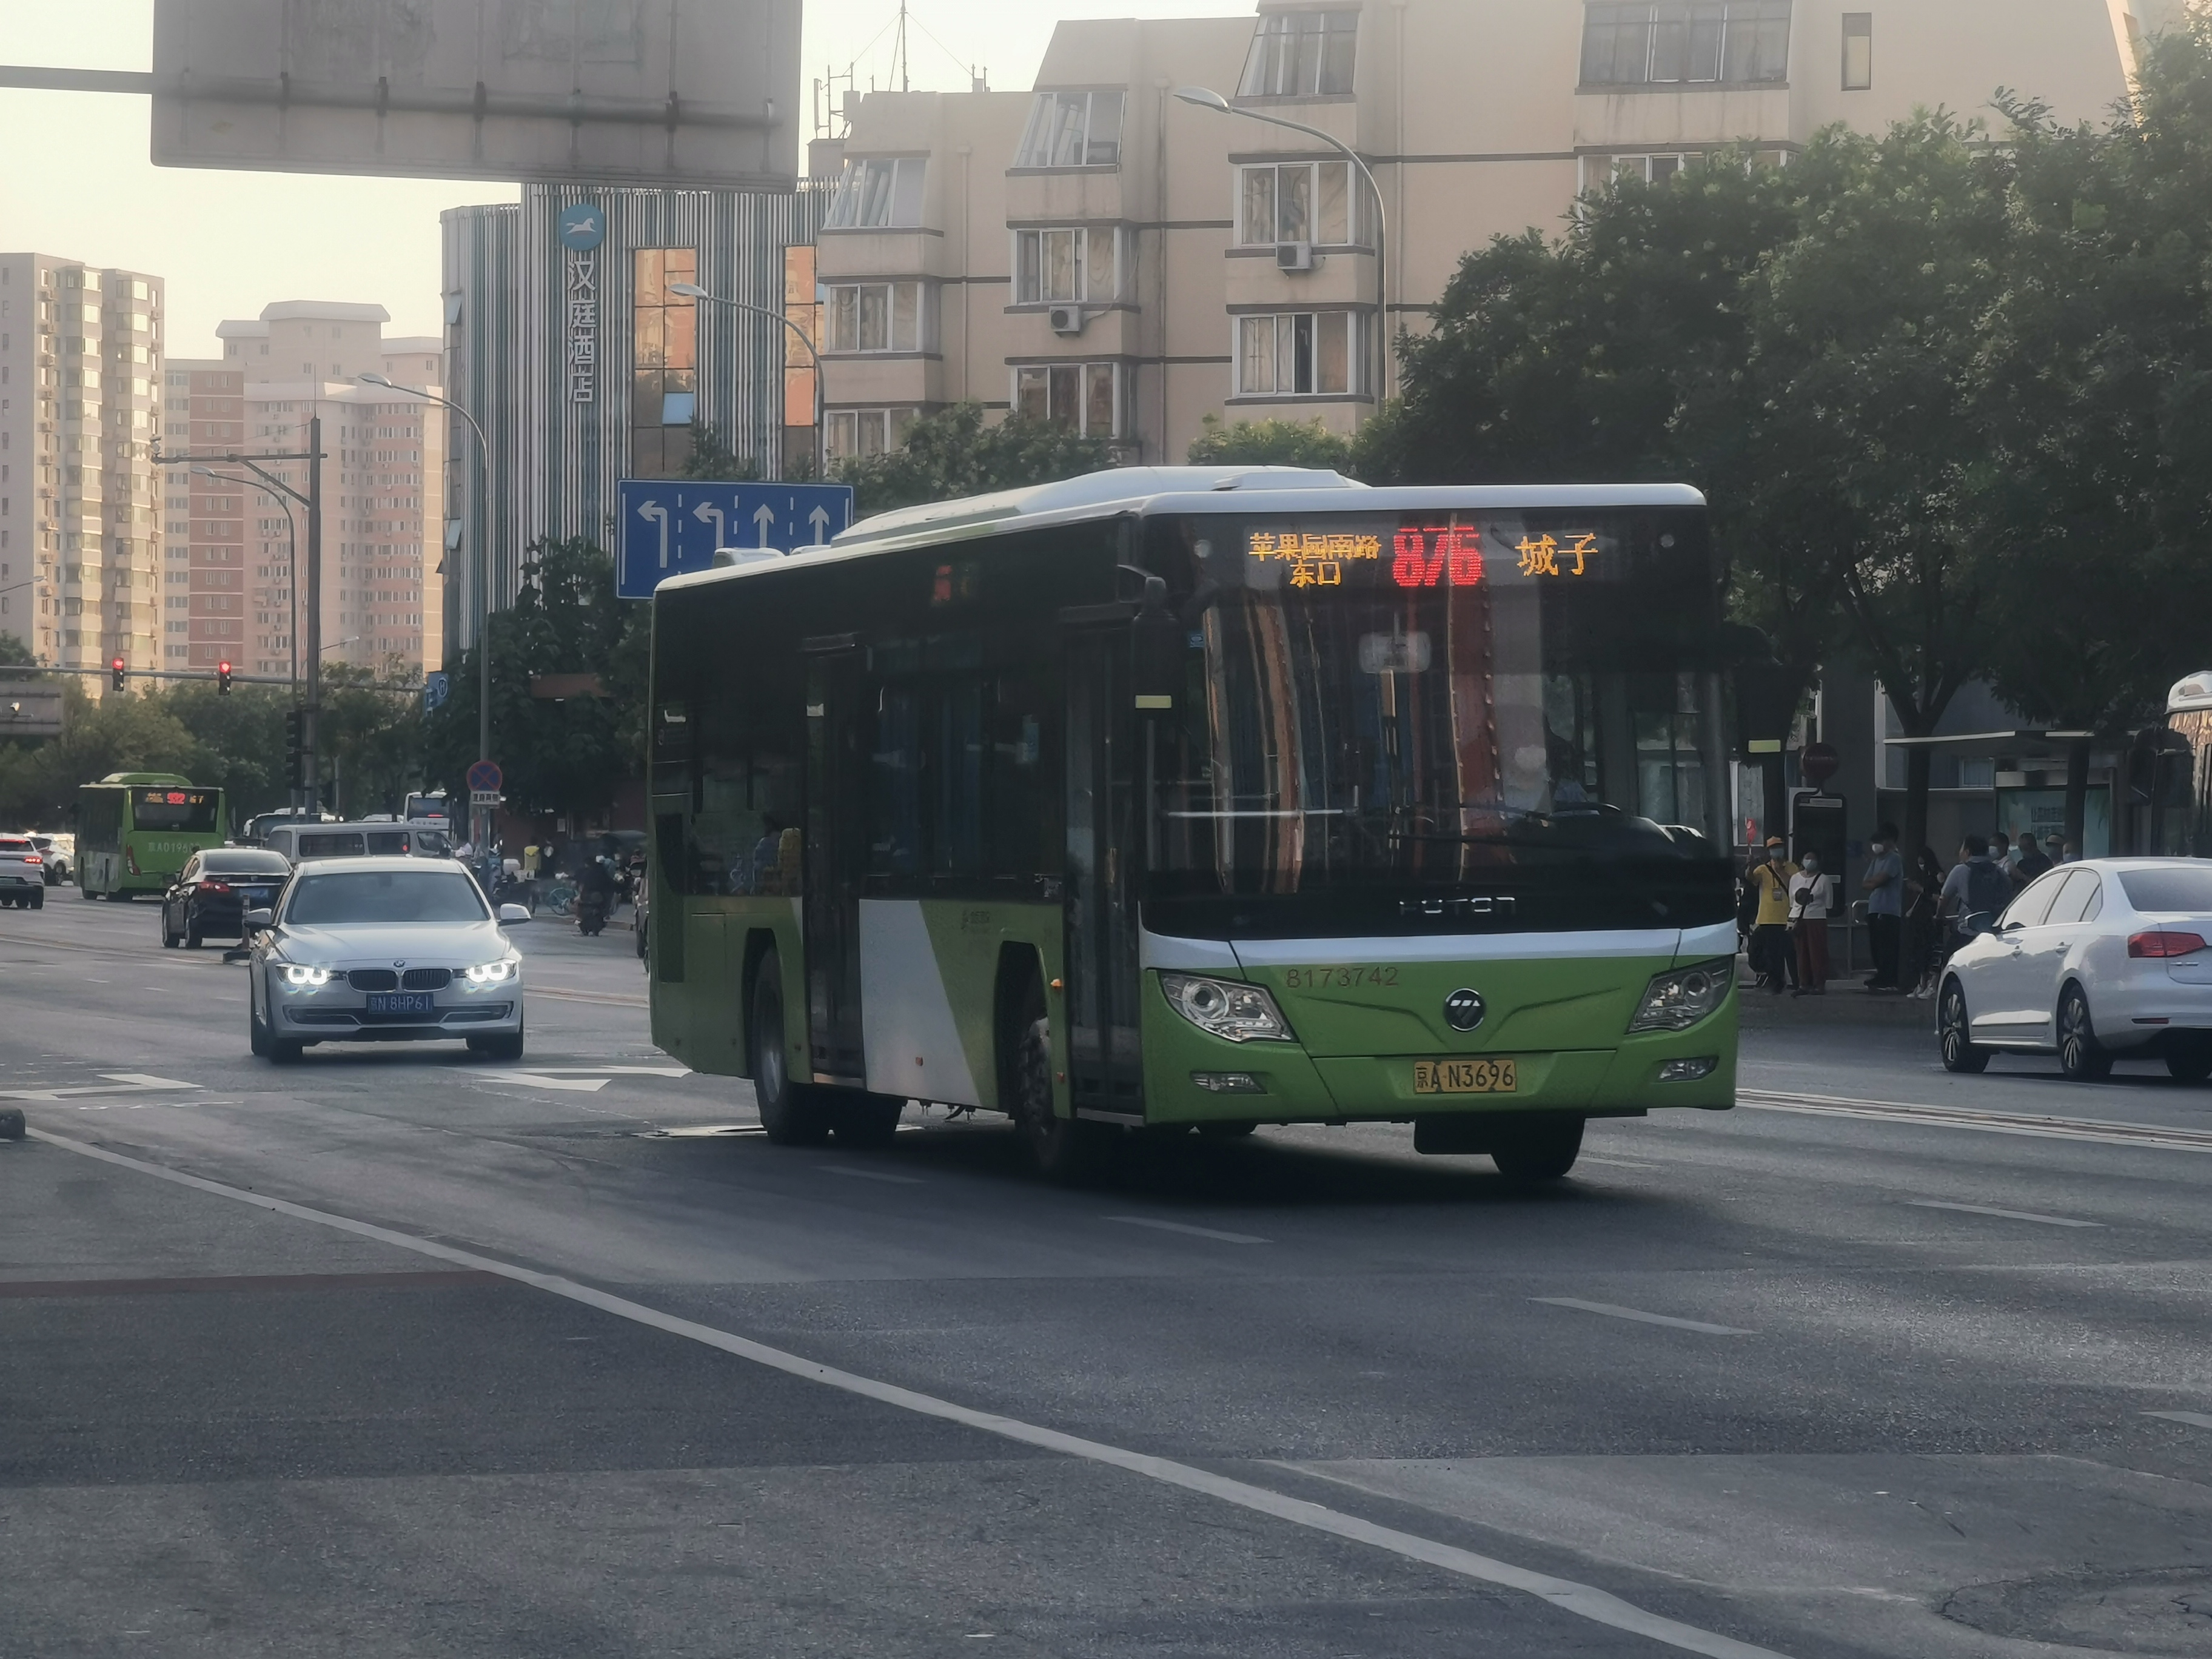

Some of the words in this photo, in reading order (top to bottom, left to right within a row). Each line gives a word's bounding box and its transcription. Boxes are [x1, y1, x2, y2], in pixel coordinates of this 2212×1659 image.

[566, 260, 597, 403] 汉庭酒店
[1248, 532, 1382, 560] 苹果园南路
[1392, 526, 1482, 587] 876
[1515, 533, 1598, 577] 城子
[1289, 559, 1341, 588] 东口
[1286, 967, 1398, 988] 8173742
